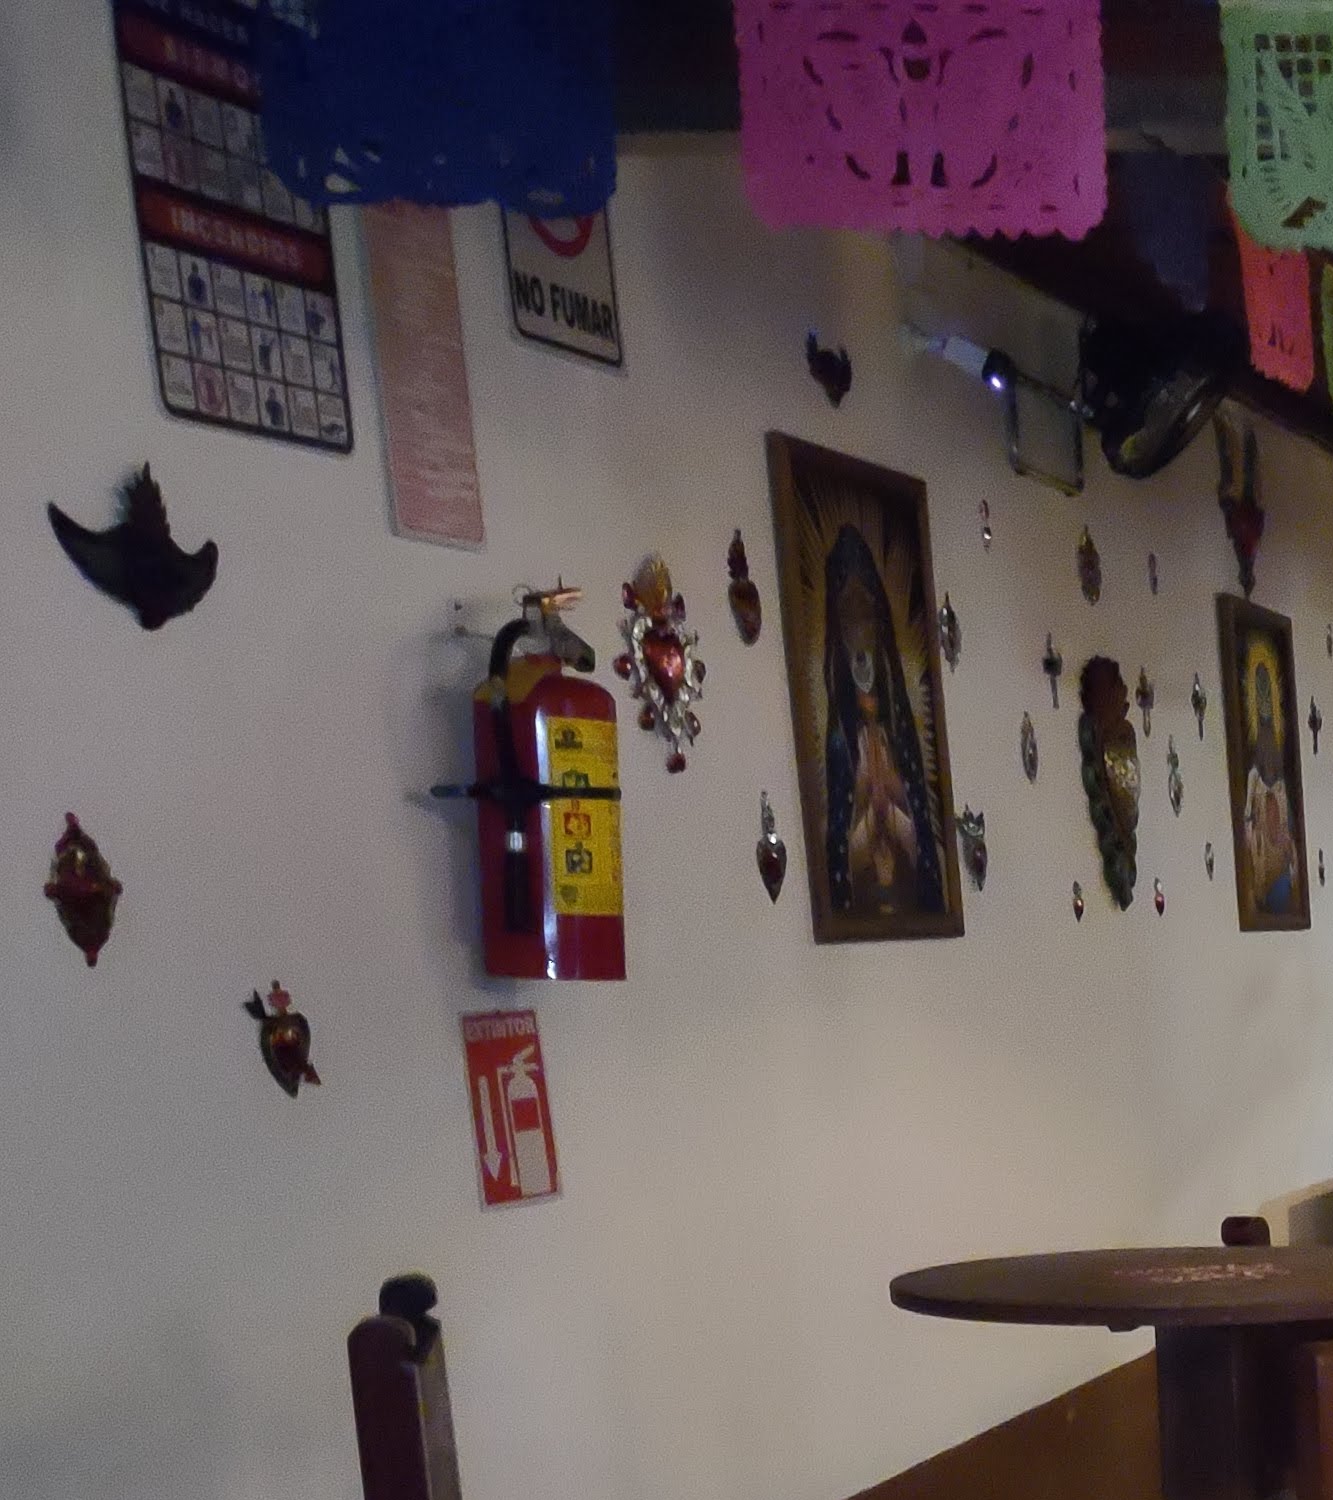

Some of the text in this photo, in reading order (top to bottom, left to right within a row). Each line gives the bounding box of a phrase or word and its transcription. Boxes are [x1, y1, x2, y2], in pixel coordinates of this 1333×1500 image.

[513, 270, 616, 343] NO FUMAR
[464, 1017, 534, 1042] EXTINTOR
